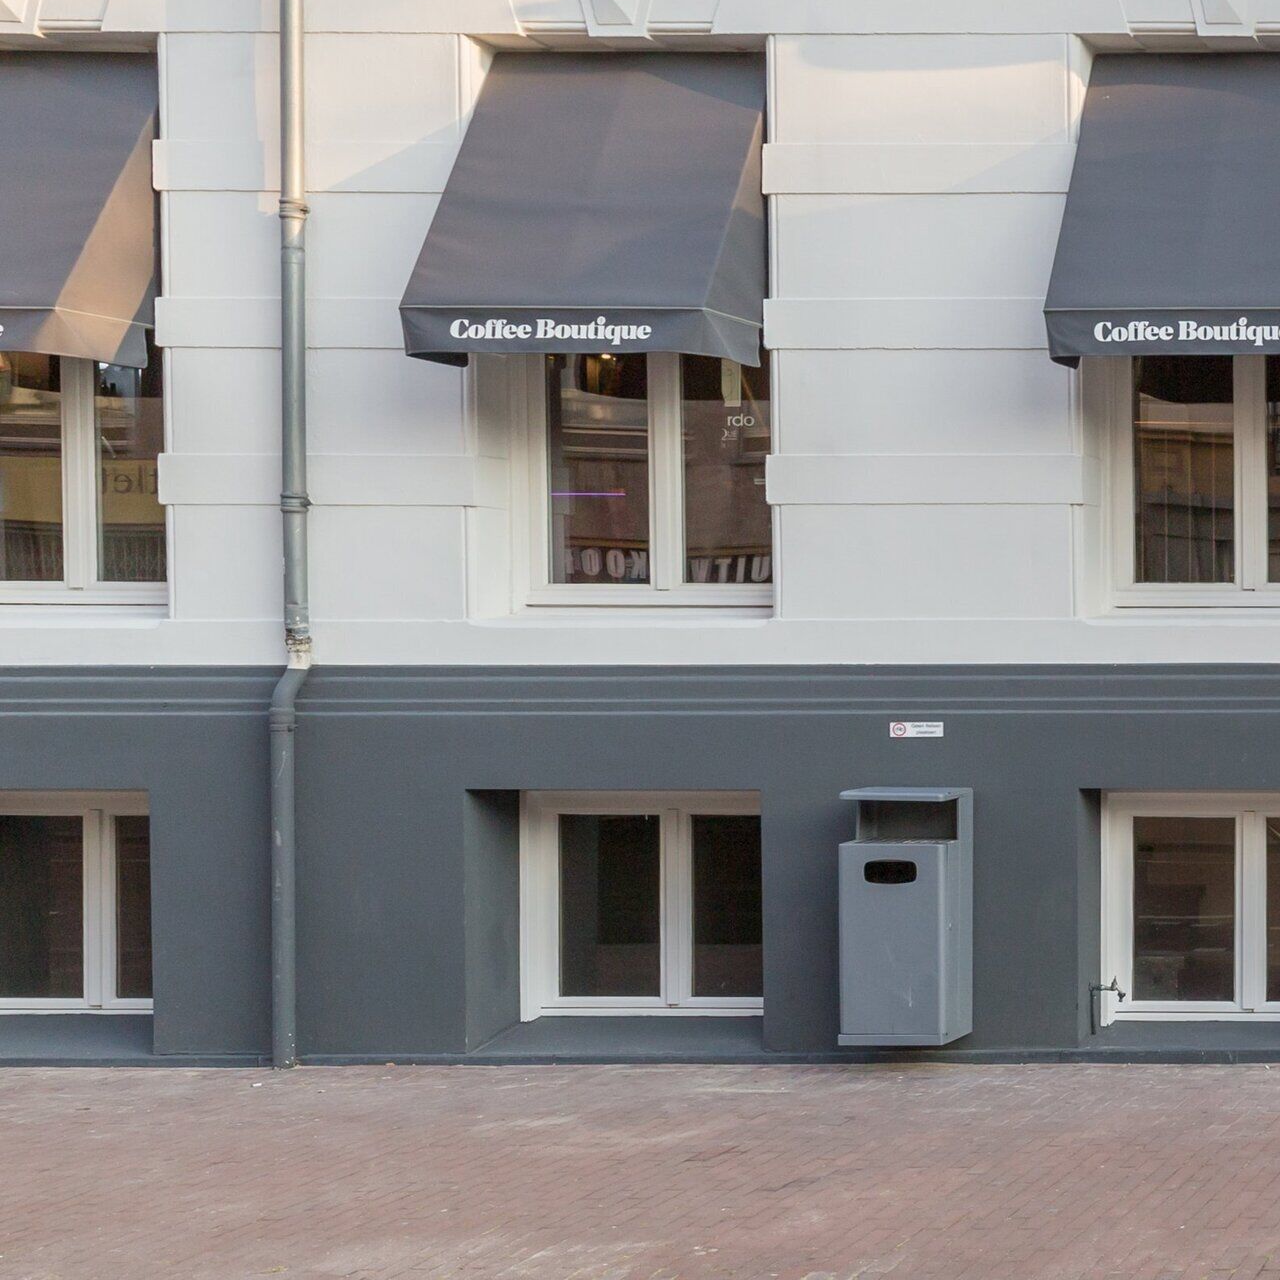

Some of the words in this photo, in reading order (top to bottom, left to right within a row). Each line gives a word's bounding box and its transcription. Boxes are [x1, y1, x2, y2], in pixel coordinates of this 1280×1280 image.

[449, 317, 532, 340] Coffee
[536, 315, 652, 345] Boutique
[1093, 320, 1174, 342] Coffee
